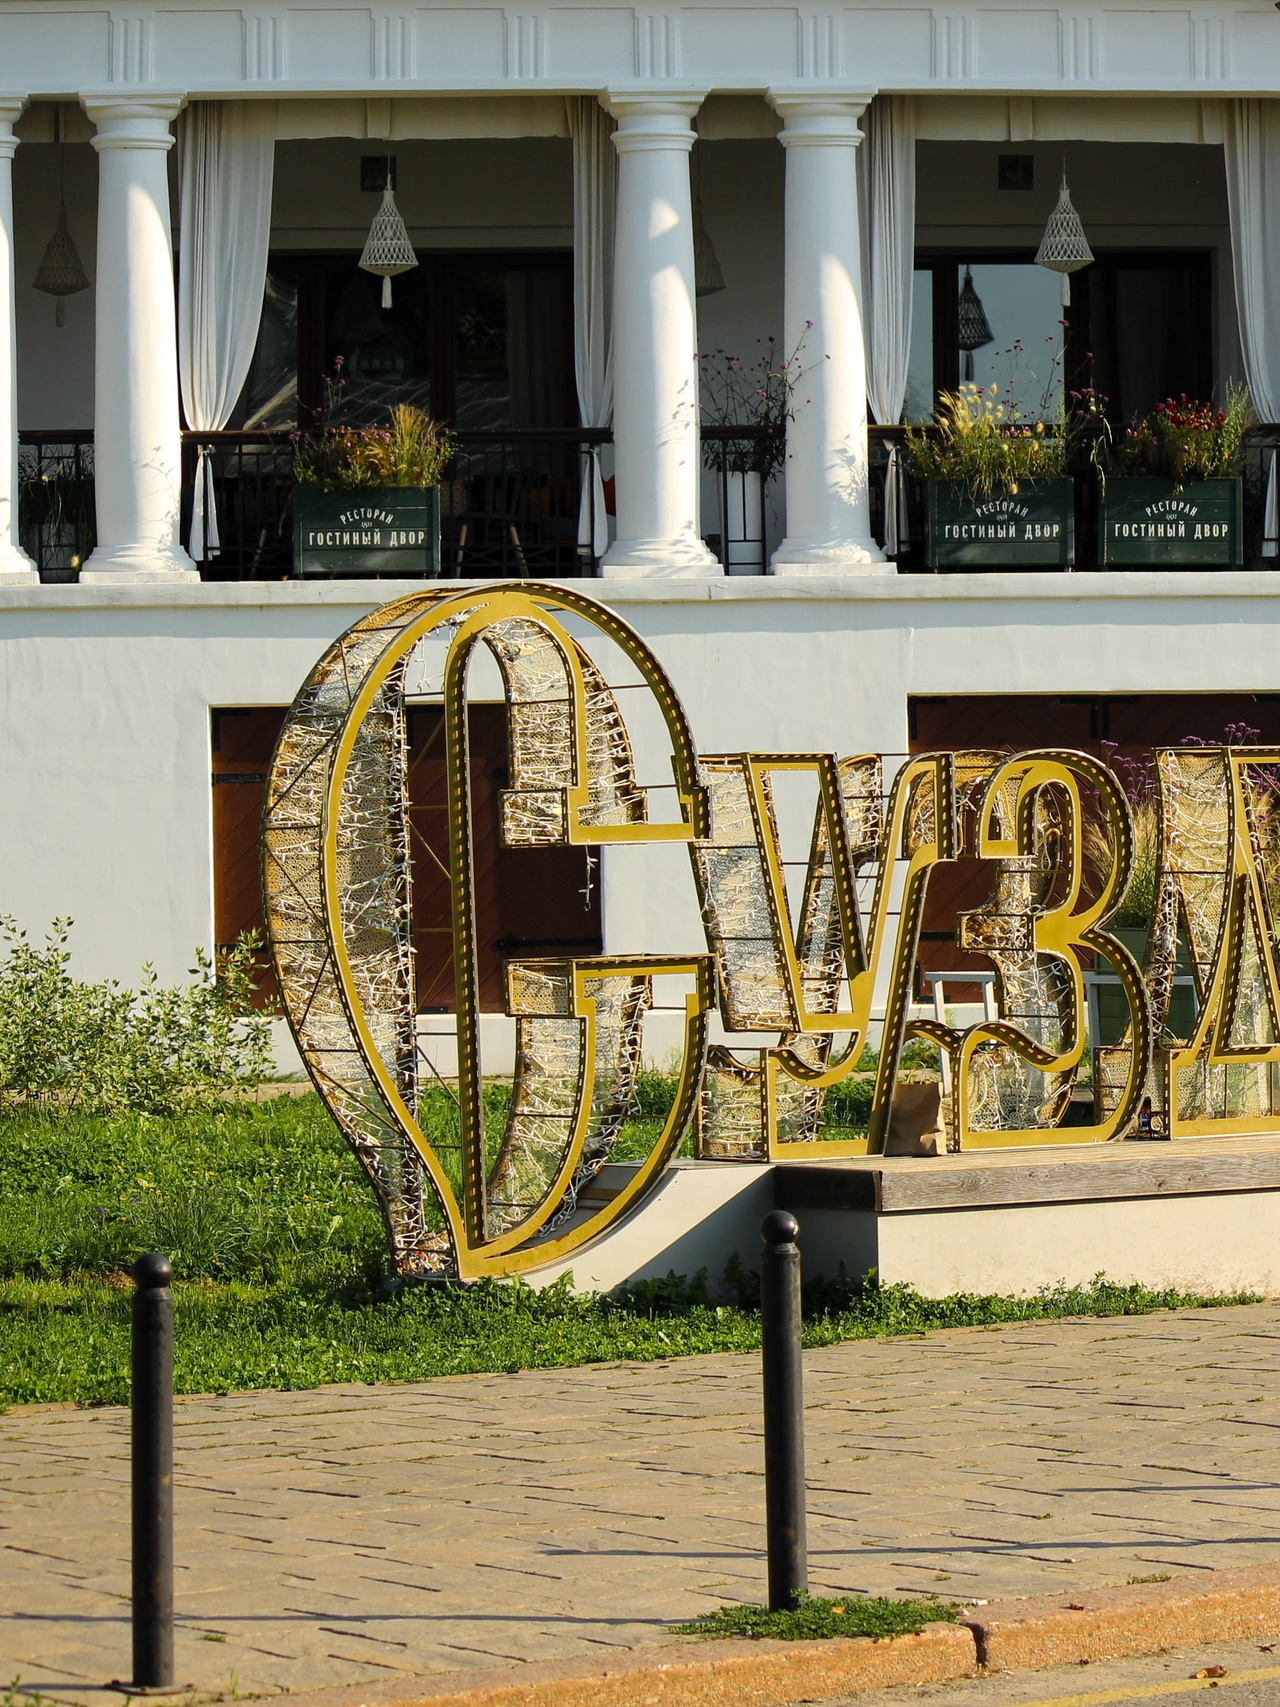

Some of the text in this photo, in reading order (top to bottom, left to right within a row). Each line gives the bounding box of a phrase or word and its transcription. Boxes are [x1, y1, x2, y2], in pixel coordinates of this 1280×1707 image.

[340, 508, 394, 525] РЕСТОРАН
[975, 501, 1029, 518] РЕСТОРАН
[1145, 500, 1198, 517] РЕСТОРАН
[309, 528, 425, 547] ГОСТИНЫЙ ДВОР
[945, 521, 1060, 540] ГОСТИНЫЙ ДВОР
[1114, 520, 1228, 540] ГОСТИНЫЙ ДВОР
